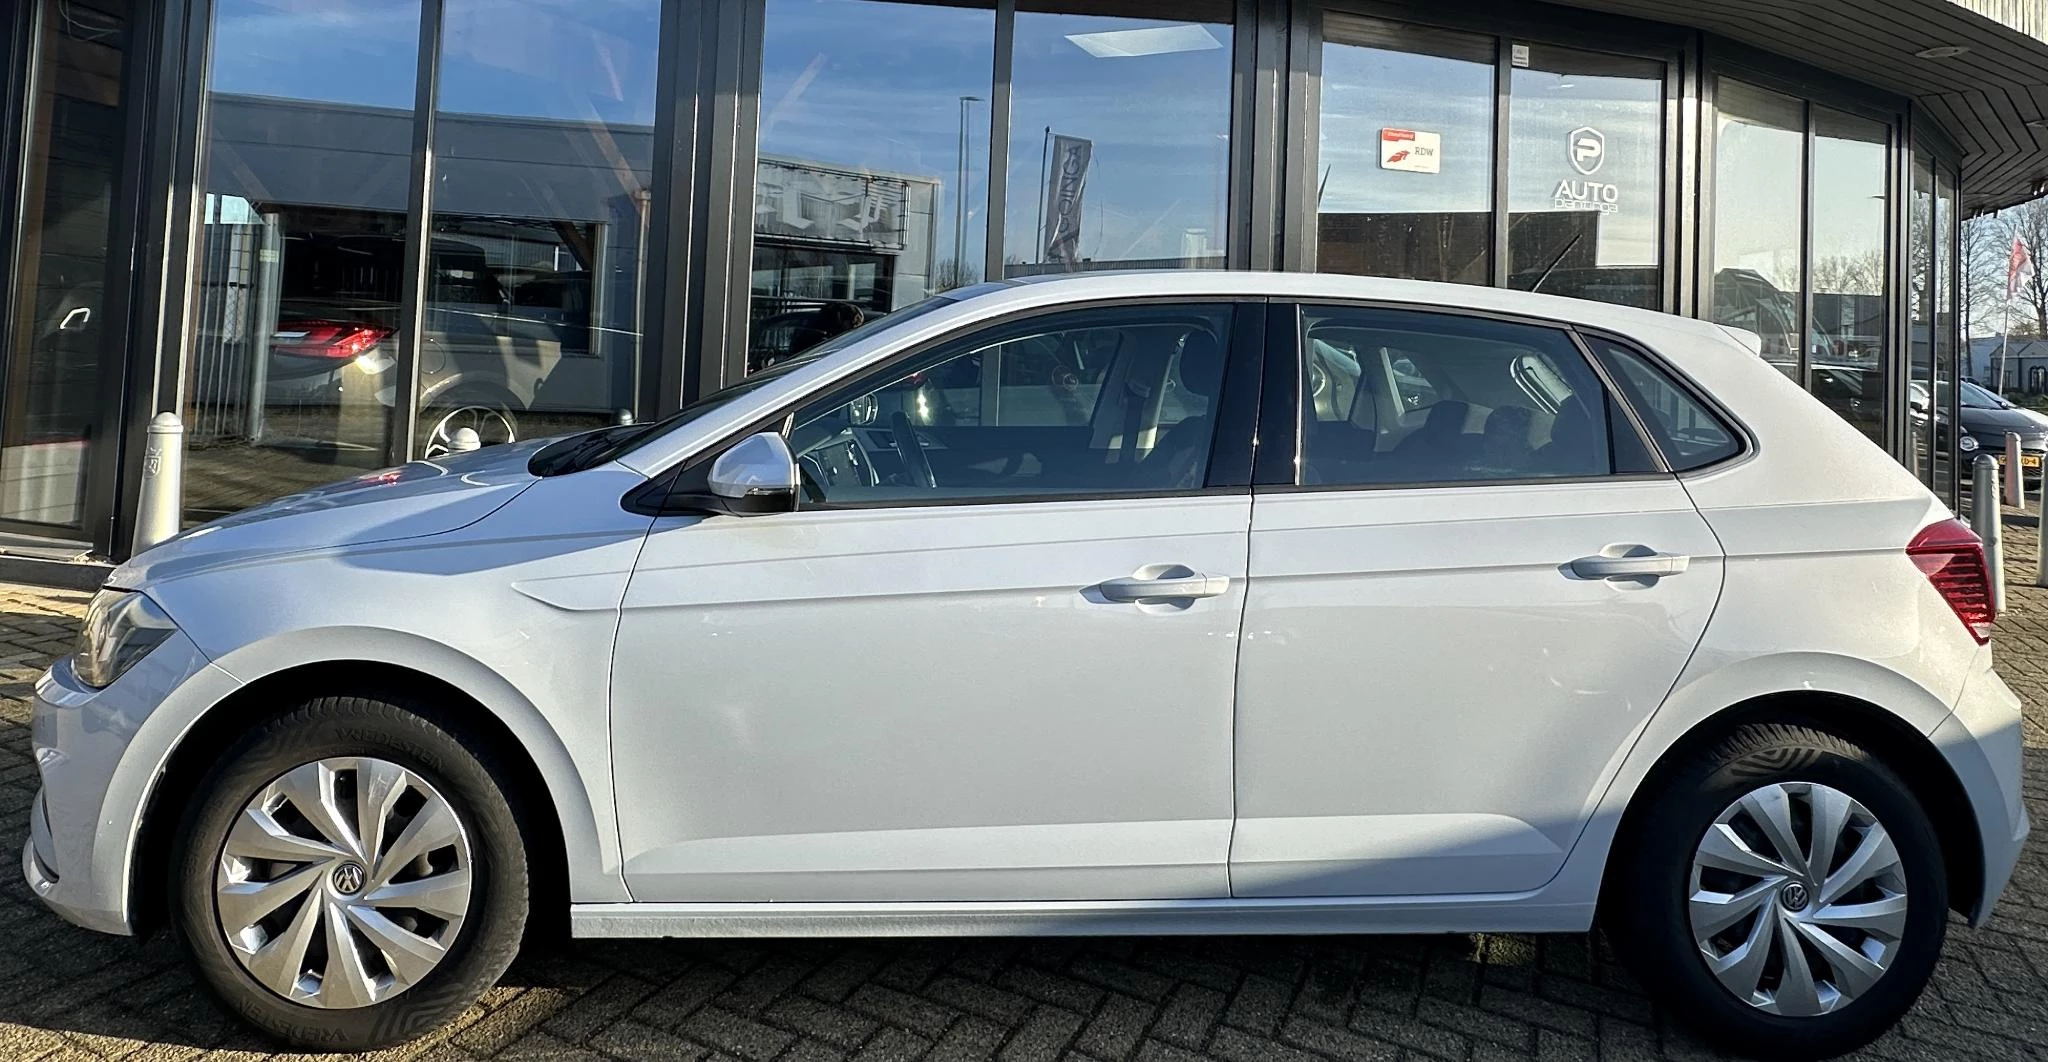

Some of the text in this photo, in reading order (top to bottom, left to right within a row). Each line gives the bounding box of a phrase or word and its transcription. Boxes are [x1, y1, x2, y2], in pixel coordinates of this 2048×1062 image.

[1414, 146, 1434, 156] RDW
[1576, 137, 1601, 161] P
[1554, 179, 1618, 203] AUTO
